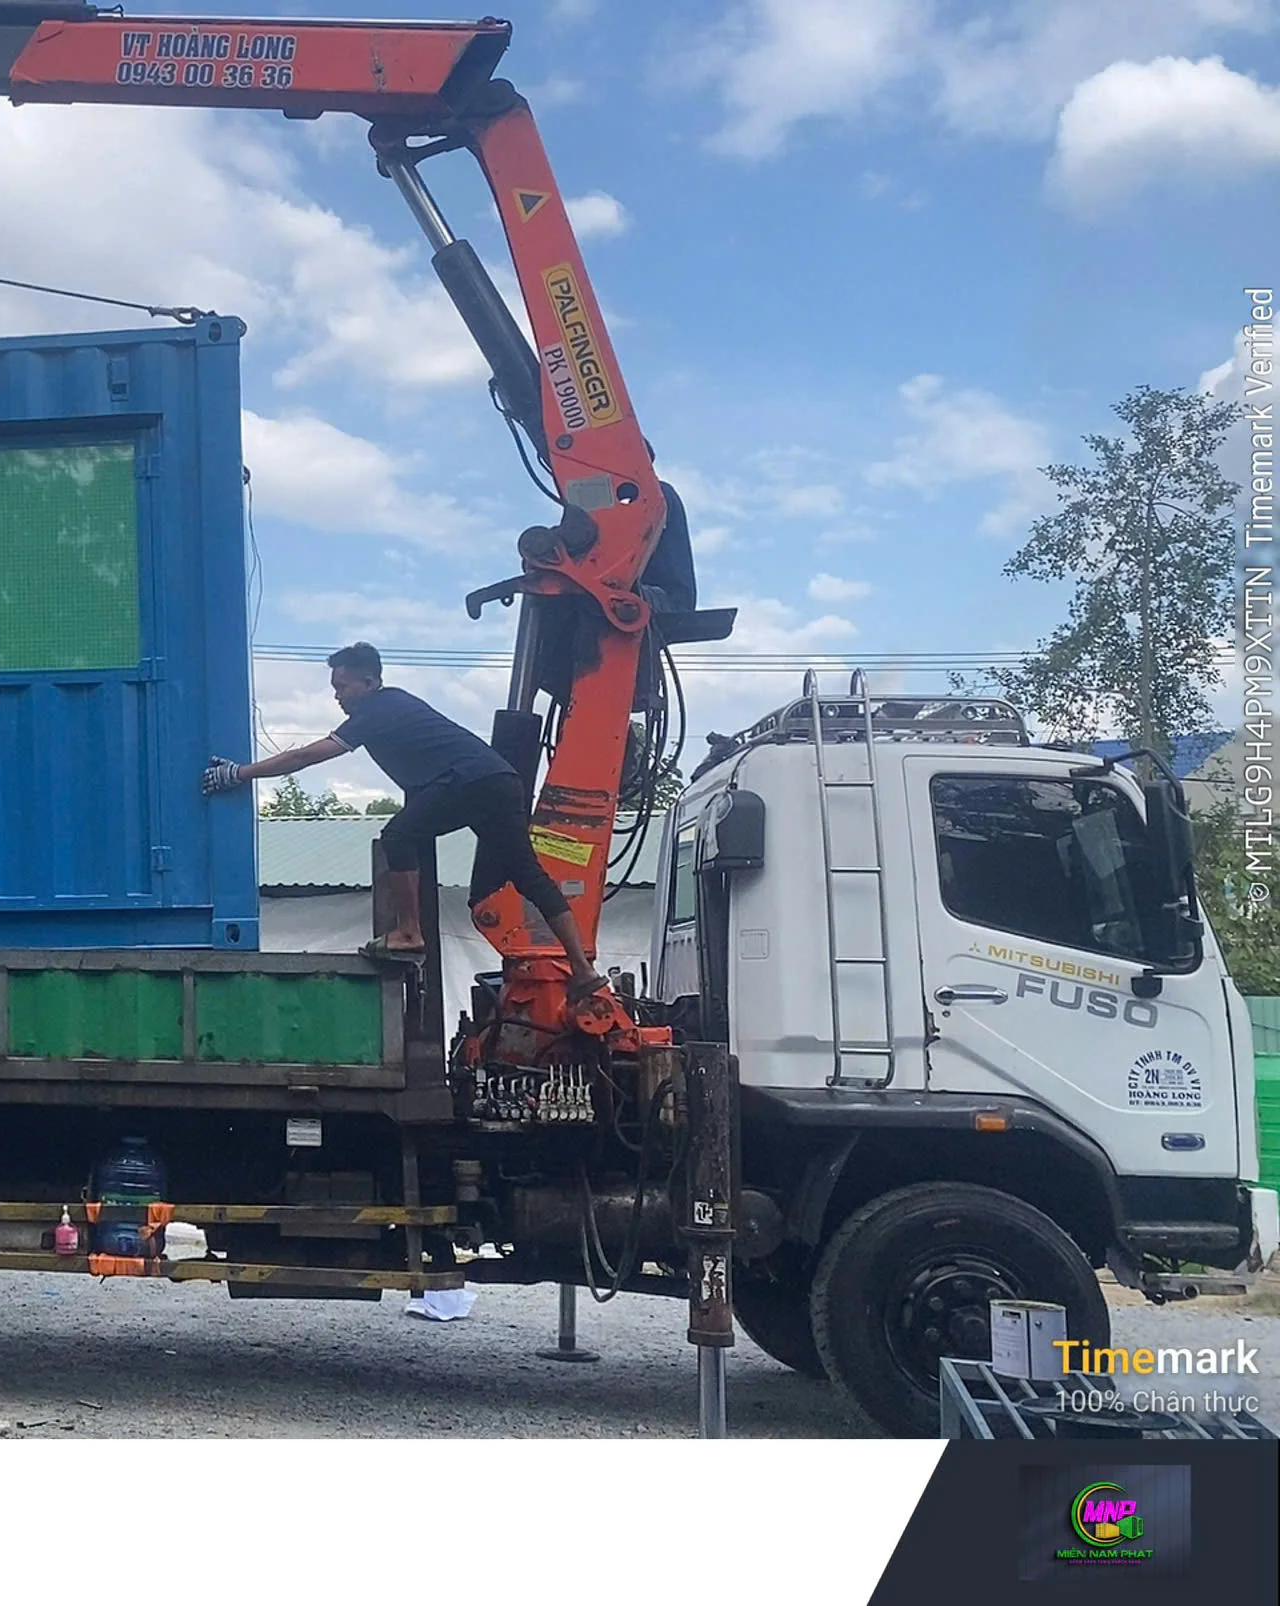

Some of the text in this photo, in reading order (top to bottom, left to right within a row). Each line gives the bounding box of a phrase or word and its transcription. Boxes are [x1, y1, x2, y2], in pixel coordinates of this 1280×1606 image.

[122, 26, 296, 61] VT HOÀNG LONG
[116, 61, 292, 89] 0943 00 36 36
[551, 276, 610, 413] PALFINGER
[544, 347, 586, 430] PK 19000
[988, 944, 1119, 986] MITSUBISHI
[1016, 973, 1158, 1028] FUSO
[1134, 1050, 1162, 1069] TNHH
[1166, 1051, 1182, 1064] TM
[1182, 1062, 1197, 1075] DV
[1190, 1079, 1201, 1090] VT
[1145, 1069, 1159, 1084] 2N
[1172, 1092, 1201, 1100] LONG
